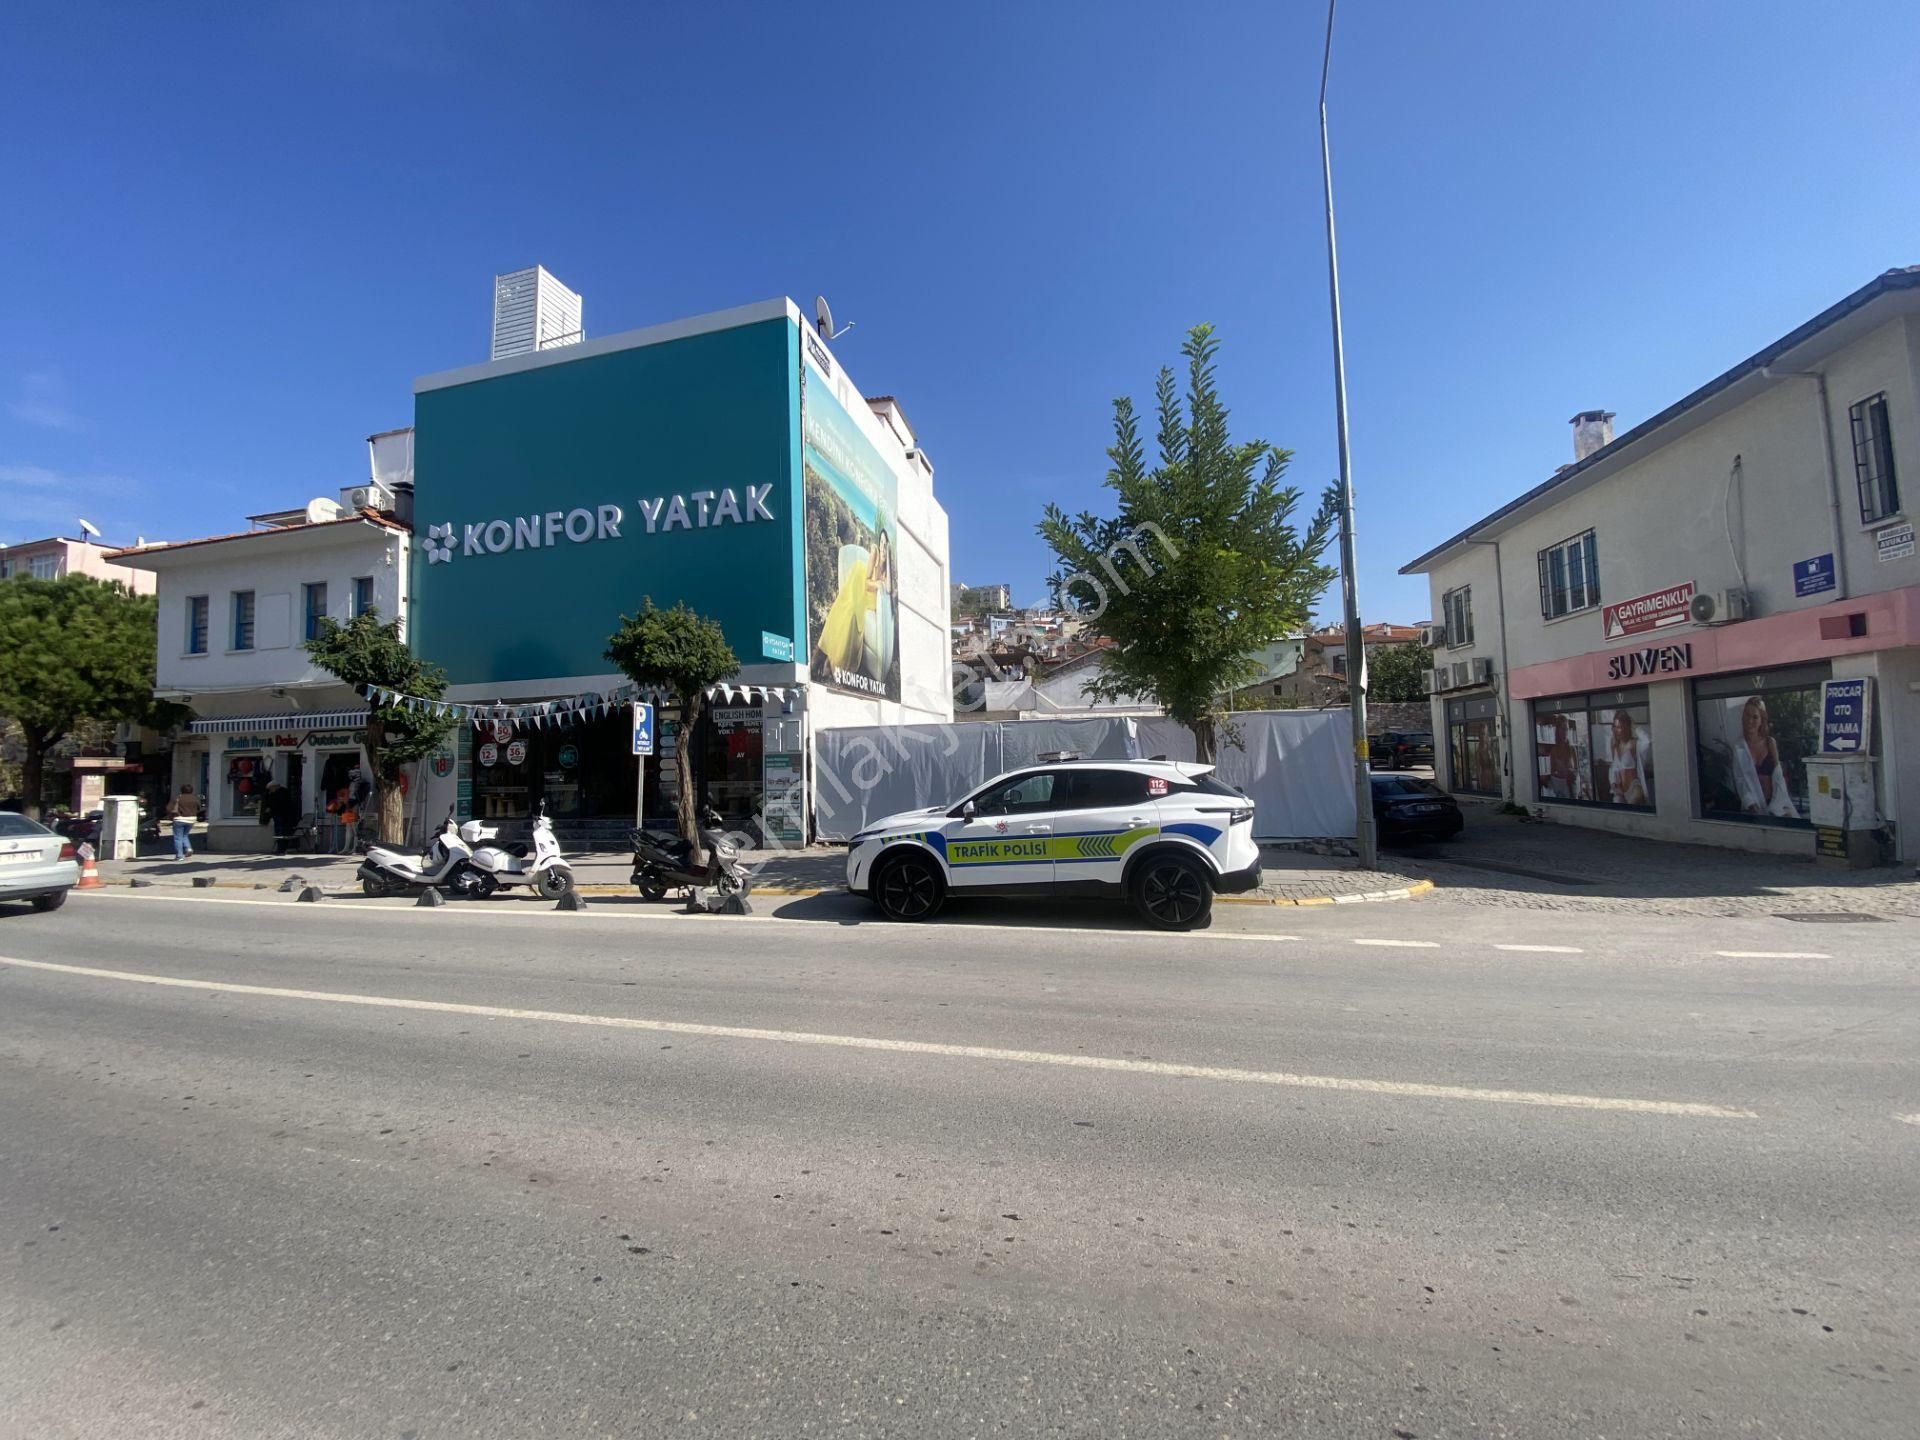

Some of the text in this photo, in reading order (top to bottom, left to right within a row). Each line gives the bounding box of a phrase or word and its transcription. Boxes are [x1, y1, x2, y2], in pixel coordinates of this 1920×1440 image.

[463, 483, 775, 556] KONFOR YATAK
[1607, 643, 1692, 680] SUWEN
[842, 669, 886, 695] KONFOR YATAK
[1826, 685, 1861, 698] PROCAR
[714, 708, 763, 720] ENGLISH HOM
[1834, 704, 1851, 716] OTO
[635, 706, 646, 730] P
[1826, 722, 1859, 734] YIKAMA
[308, 733, 350, 746] Outdoor
[481, 750, 491, 759] 12
[509, 746, 520, 756] 36
[1150, 779, 1165, 788] 112
[954, 841, 1047, 858] TRAFİK POLİSİ
